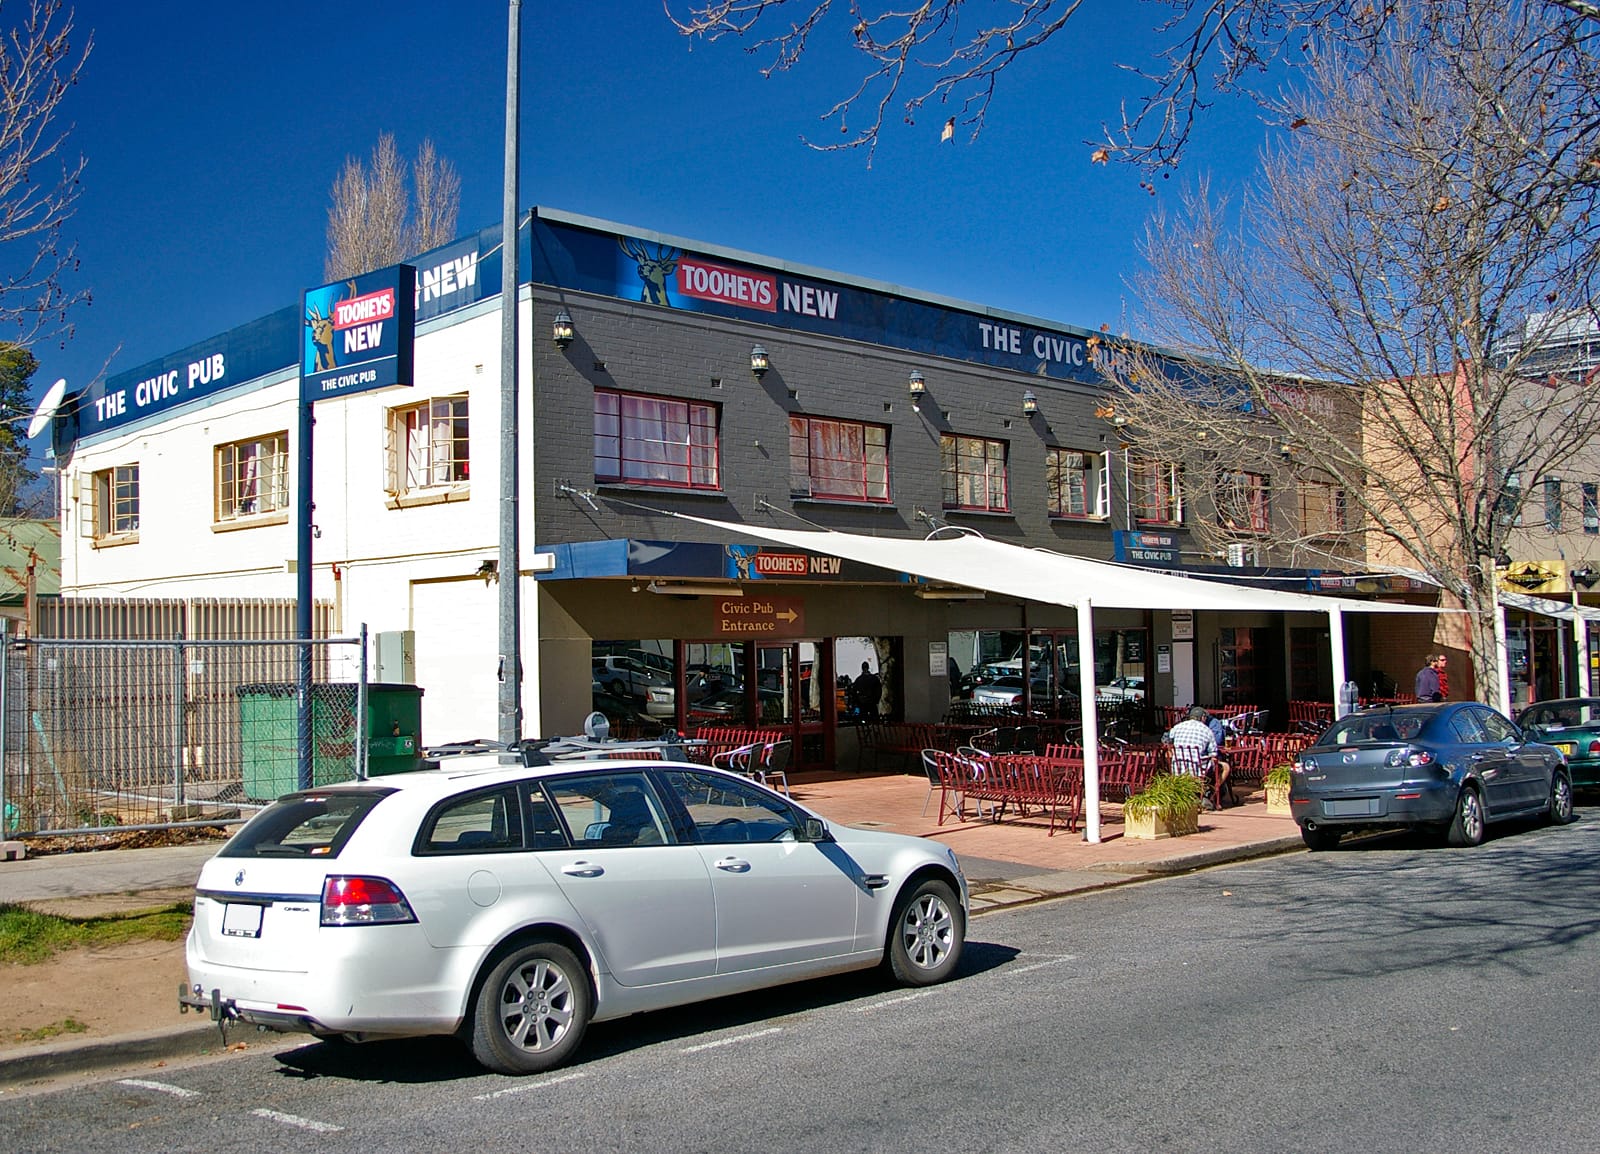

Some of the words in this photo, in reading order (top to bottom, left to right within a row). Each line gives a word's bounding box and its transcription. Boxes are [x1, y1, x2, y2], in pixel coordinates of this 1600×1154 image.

[423, 251, 478, 303] NEW
[682, 264, 772, 305] TOOHEYS
[783, 282, 839, 320] NEW
[337, 294, 390, 325] TOOHEYS
[344, 322, 384, 354] NEW
[979, 322, 1022, 355] THE
[1033, 335, 1083, 367] CIVIC
[95, 390, 127, 422] THE
[135, 370, 178, 407] CIVIC
[188, 353, 225, 389] PUB
[321, 378, 337, 391] THE
[338, 373, 359, 387] CIVIC
[359, 369, 377, 382] PUB
[757, 556, 805, 572] TOOHEYS
[810, 557, 842, 574] NEW
[1131, 550, 1144, 560] THE
[1144, 551, 1160, 560] CIVIC
[1160, 552, 1172, 561] PUB
[721, 602, 750, 614] Civic
[753, 602, 774, 614] Pub
[721, 620, 775, 632] Entrance
